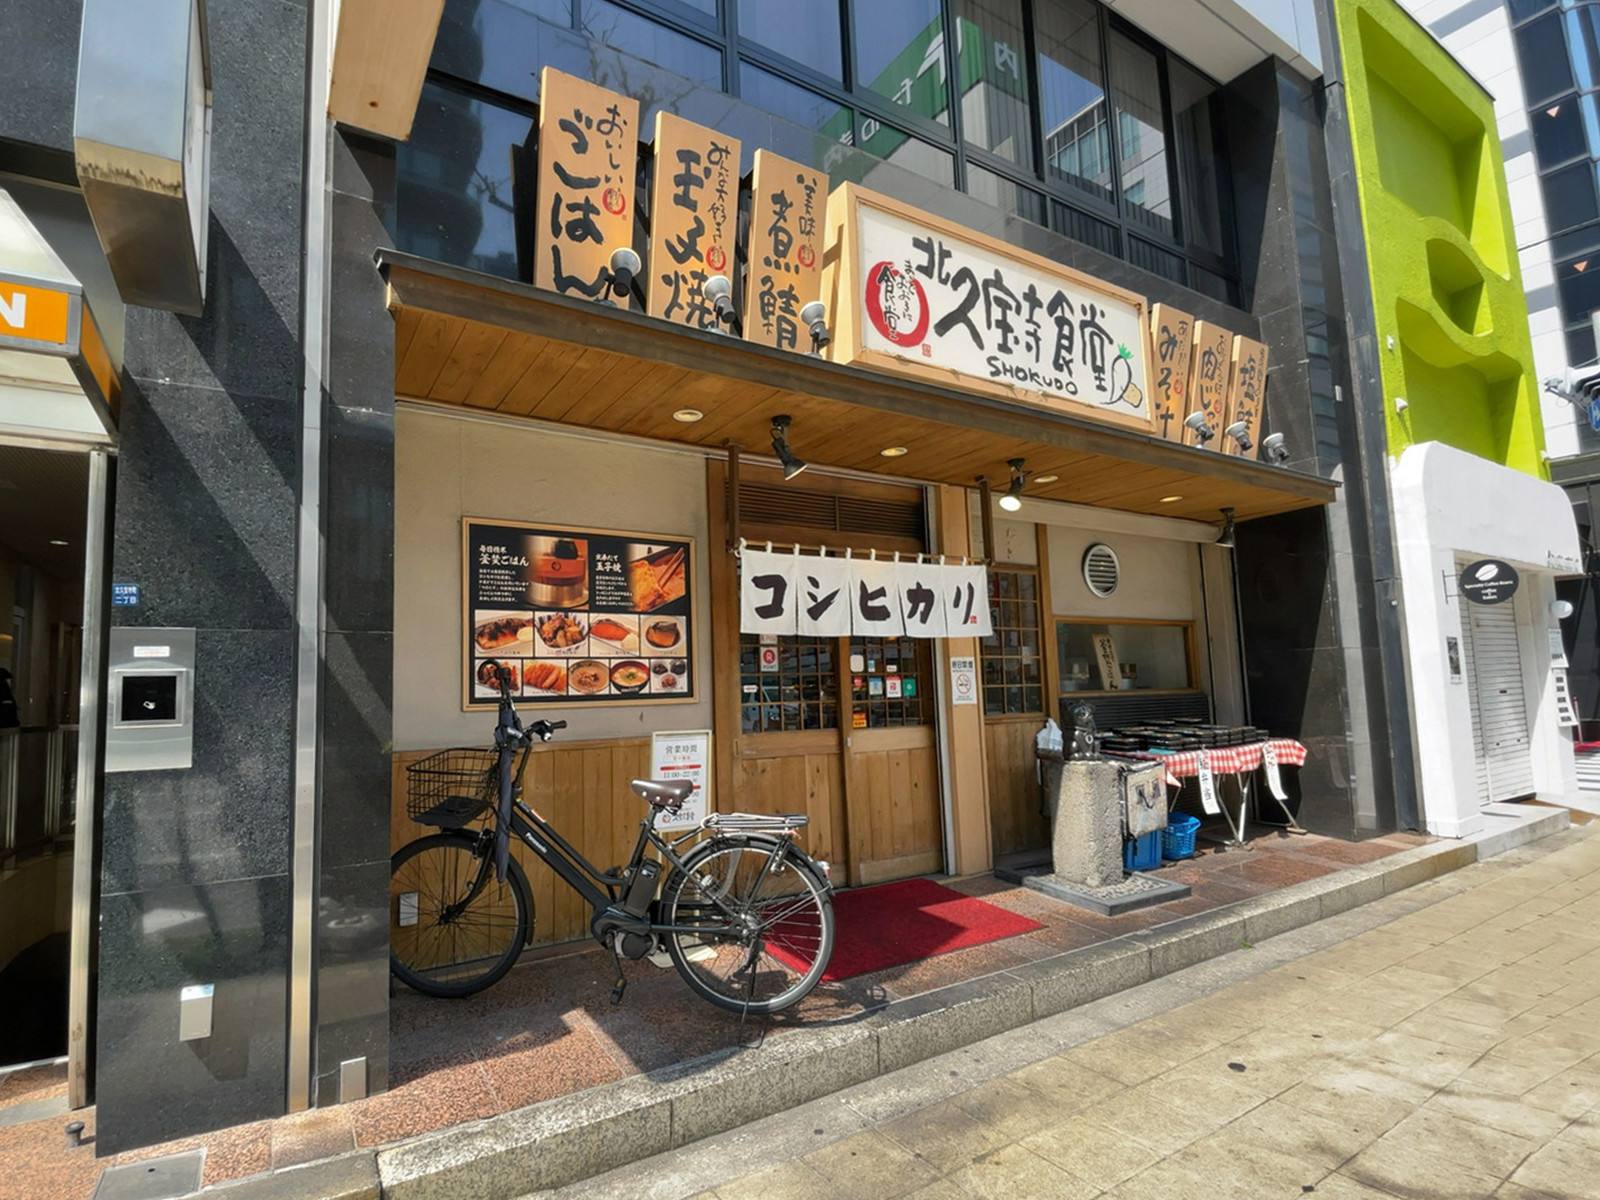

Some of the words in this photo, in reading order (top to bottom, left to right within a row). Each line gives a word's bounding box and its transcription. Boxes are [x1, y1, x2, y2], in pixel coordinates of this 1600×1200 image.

[597, 103, 628, 184] おいしい
[551, 108, 609, 297] ごはん
[662, 148, 717, 330] 玉子焼
[912, 236, 1114, 392] 北久宝寺食堂
[986, 355, 1078, 396] SHOKUDO
[1154, 325, 1179, 438] みそ汁
[751, 574, 975, 625] コシヒカリ
